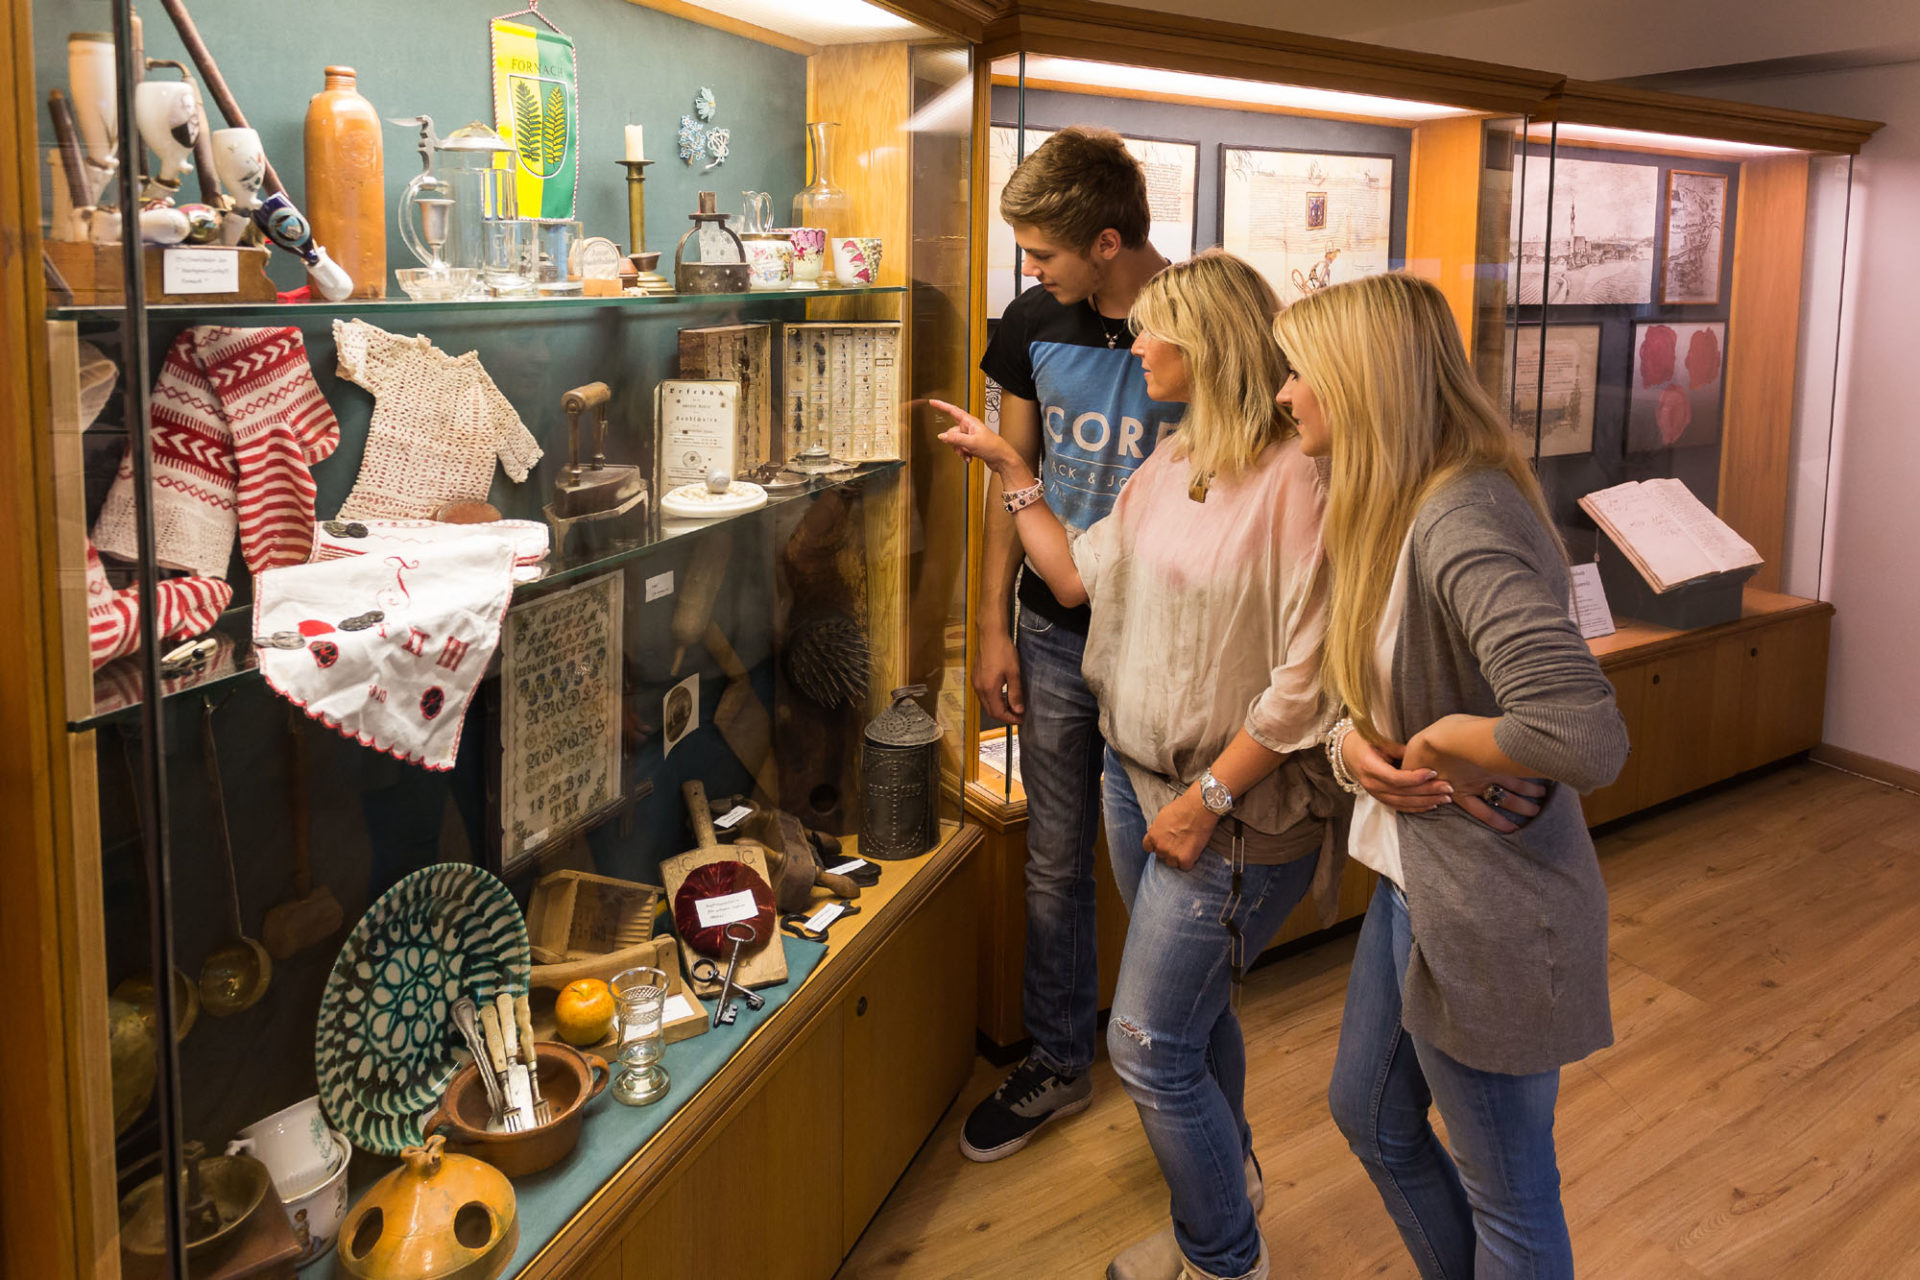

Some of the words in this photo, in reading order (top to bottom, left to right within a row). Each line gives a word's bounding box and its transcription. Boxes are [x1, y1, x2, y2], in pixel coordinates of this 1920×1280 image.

[511, 58, 564, 77] FORNACH
[1052, 461, 1077, 480] ACK
[1087, 472, 1097, 485] &
